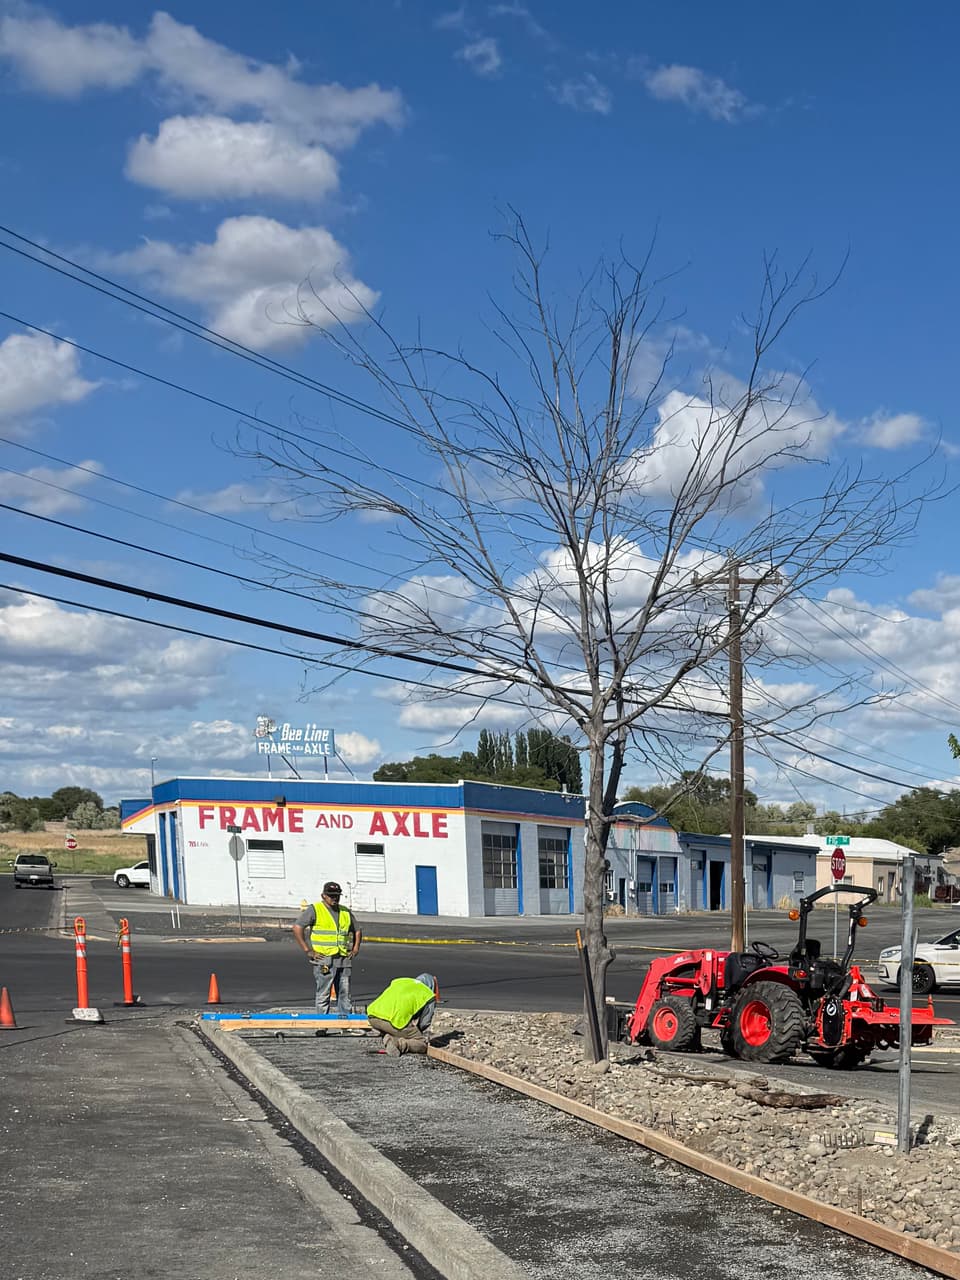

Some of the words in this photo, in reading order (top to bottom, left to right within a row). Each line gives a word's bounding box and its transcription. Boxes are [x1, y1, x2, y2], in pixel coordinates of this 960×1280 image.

[281, 723, 302, 741] Bee
[304, 723, 329, 741] Line
[258, 742, 291, 754] FRAME
[304, 743, 330, 755] AXLE
[199, 805, 304, 833] FRAME
[315, 813, 354, 829] AND
[369, 811, 448, 838] AXLE
[831, 857, 845, 870] STOP
